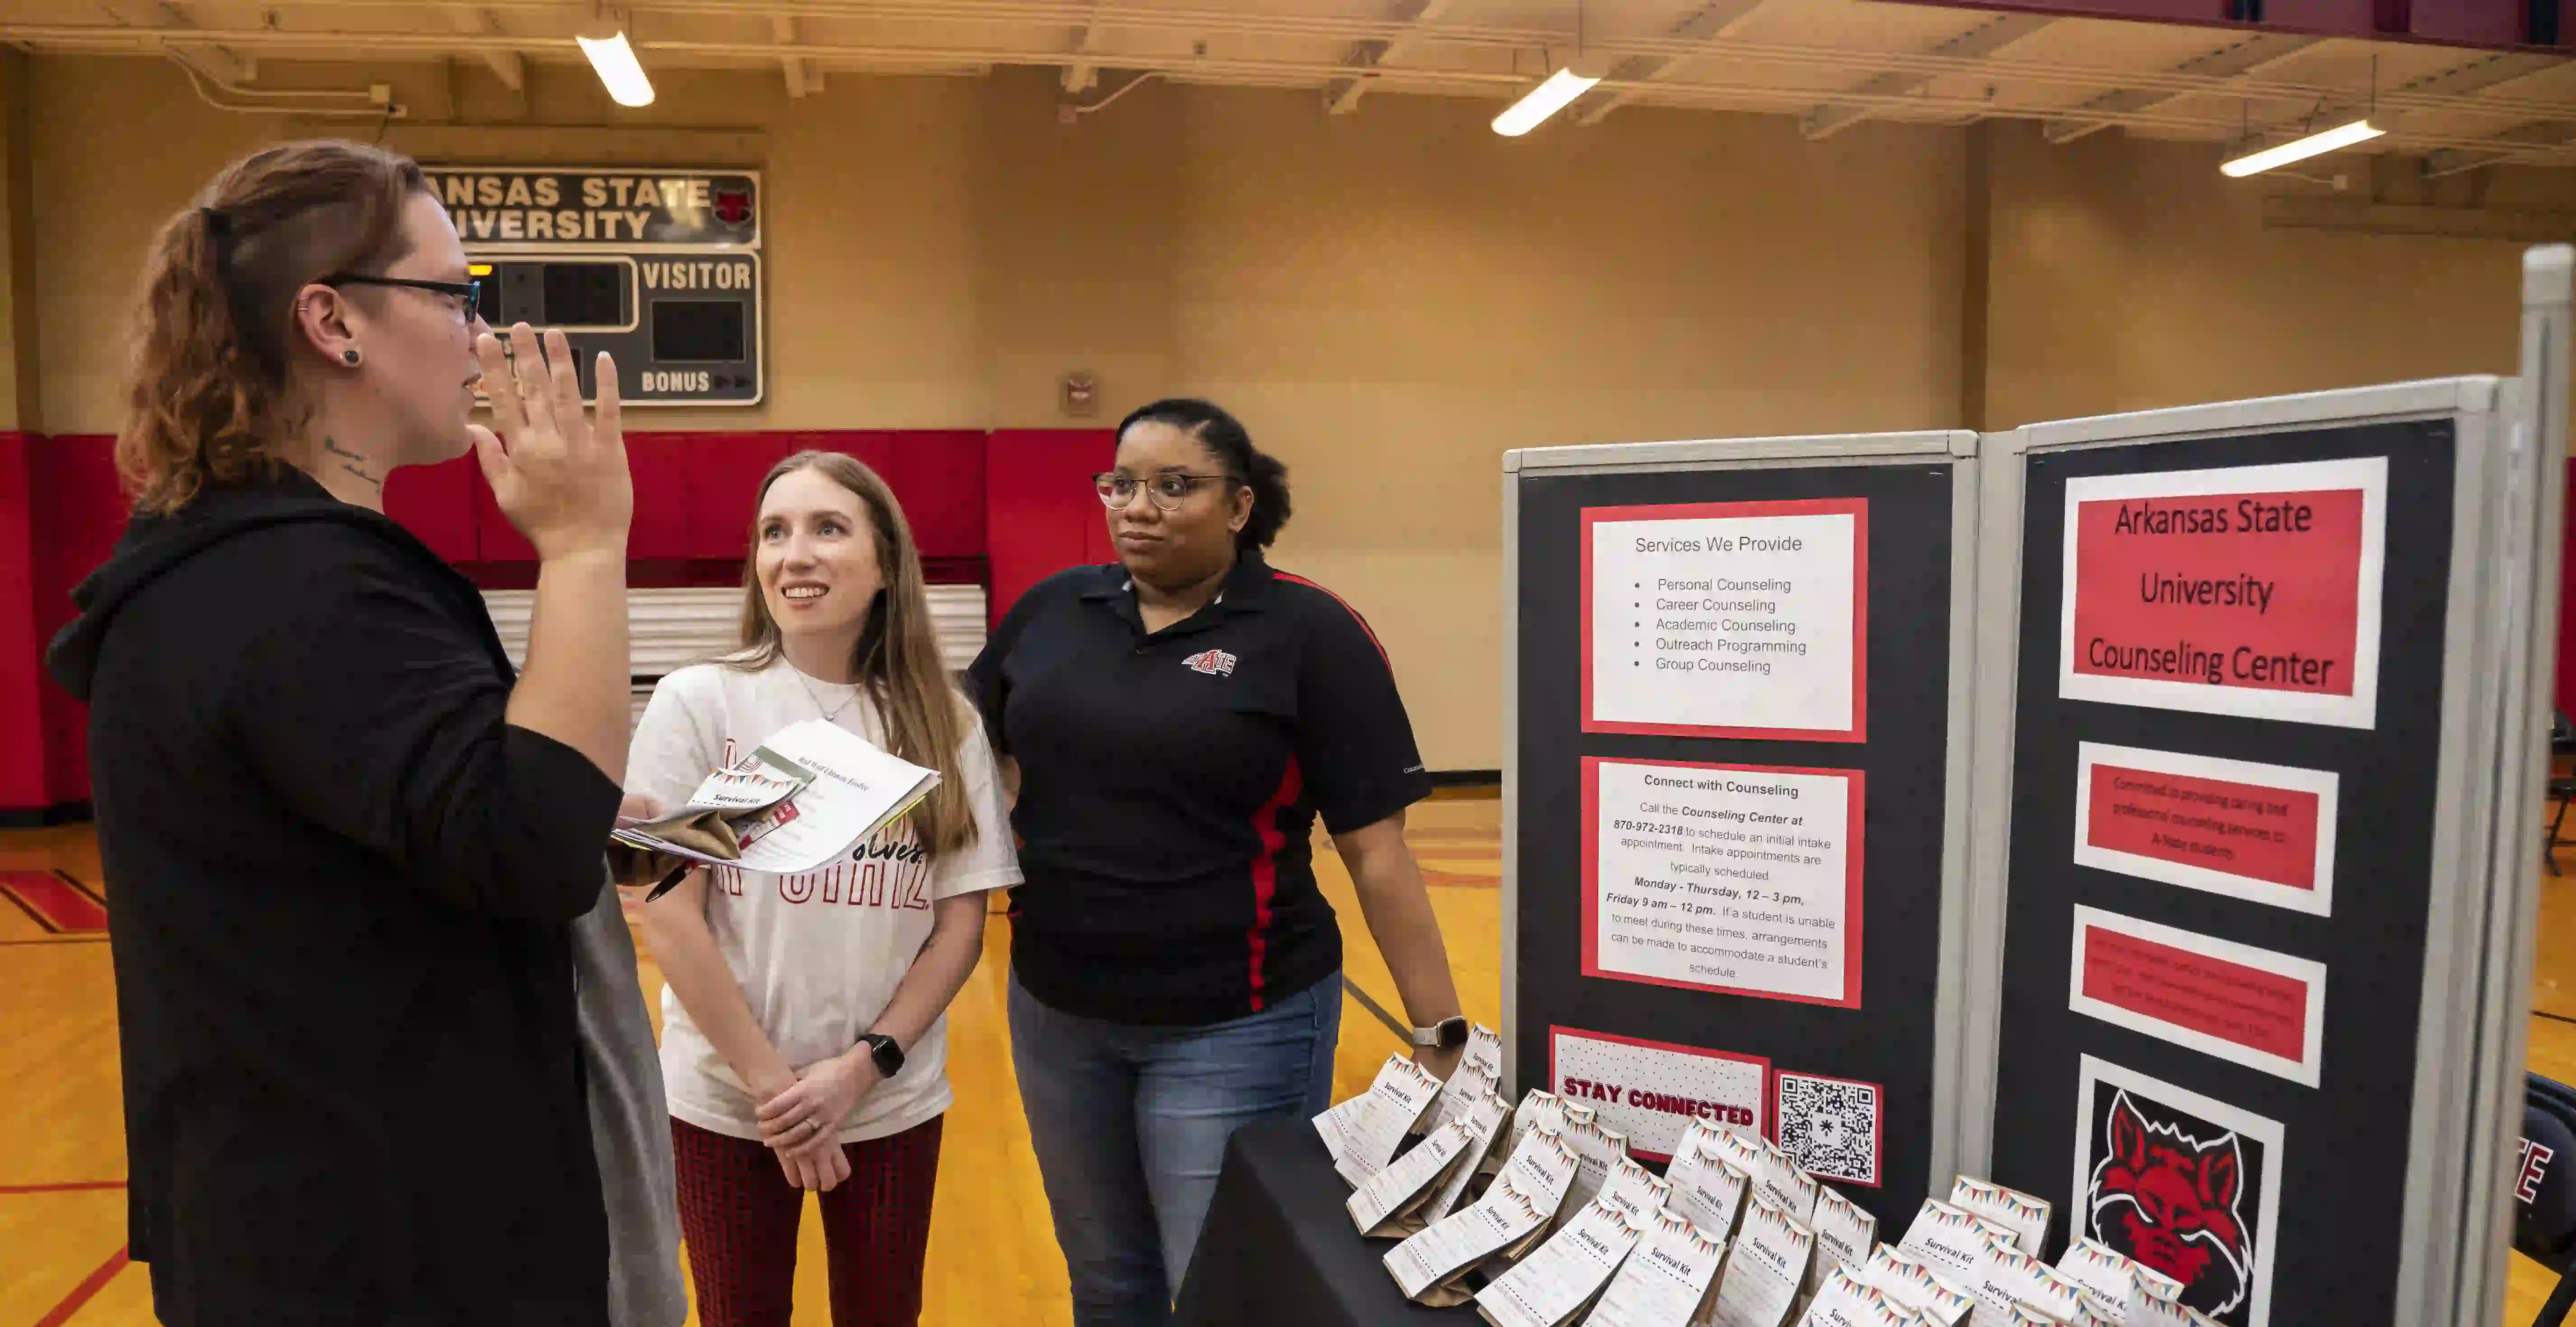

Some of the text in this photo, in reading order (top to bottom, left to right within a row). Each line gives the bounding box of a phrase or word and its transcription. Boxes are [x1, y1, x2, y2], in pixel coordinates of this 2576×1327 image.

[583, 178, 710, 208] STATE
[643, 263, 751, 289] VISITOR
[642, 372, 709, 391] BONUS
[2115, 499, 2312, 534] Arkansas State
[1636, 536, 1801, 552] Services We Provide
[1658, 578, 1791, 593] Personal Counseling
[2142, 573, 2273, 614] University
[1657, 598, 1775, 614] Career Counseling
[1657, 618, 1795, 635] Academic Counseling
[1657, 638, 1806, 656] Outreach Programming
[1657, 657, 1771, 675] Group Counseling
[2090, 638, 2334, 687] Counseling Center
[714, 794, 748, 803] Survival
[1644, 775, 1799, 800] Connect with Counseling
[1640, 802, 1803, 825] Call the Counseling Center at
[1614, 819, 1831, 850] 870-972-2318 to schedule an initial intake
[1621, 837, 1821, 865] appointment. Intake appointments are
[1671, 861, 1768, 881] typically scheduled
[1635, 876, 1677, 893] Monday
[1687, 883, 1741, 900] Thursday,
[1747, 888, 1759, 900] 12
[1772, 892, 1779, 901] 3
[1783, 895, 1804, 906] pm,
[1607, 893, 1638, 907] Friday
[1642, 897, 1648, 907] 9
[1651, 901, 1668, 910] am
[1680, 902, 1693, 912] 12
[1695, 907, 1717, 916] pm.
[1723, 906, 1730, 916] If
[1732, 909, 1739, 917] a
[1742, 908, 1783, 924] student
[1786, 913, 1795, 924] is
[1799, 916, 1835, 929] unable
[1612, 913, 1828, 950] to meet during these times, arrangements
[1611, 933, 1629, 945] can
[1632, 934, 1643, 945] be
[1647, 936, 1675, 949] made
[1678, 941, 1687, 951] to
[1691, 944, 1764, 962] accommodate
[1778, 955, 1827, 968] student's
[1689, 964, 1738, 978] schedule.
[1385, 1082, 1403, 1099] Survival
[1564, 1076, 1754, 1127] STAY CONNECTED
[1526, 1155, 1546, 1178] Survival
[1613, 1191, 1631, 1211] Survival
[1697, 1185, 1715, 1206] Survival
[1766, 1179, 1789, 1204] Survival
[1578, 1229, 1601, 1249] Survival
[1753, 1237, 1777, 1262] Survival
[1821, 1229, 1844, 1251] Survival
[1925, 1238, 1974, 1264] Survival Kit
[1651, 1247, 1691, 1276] Survival Kit
